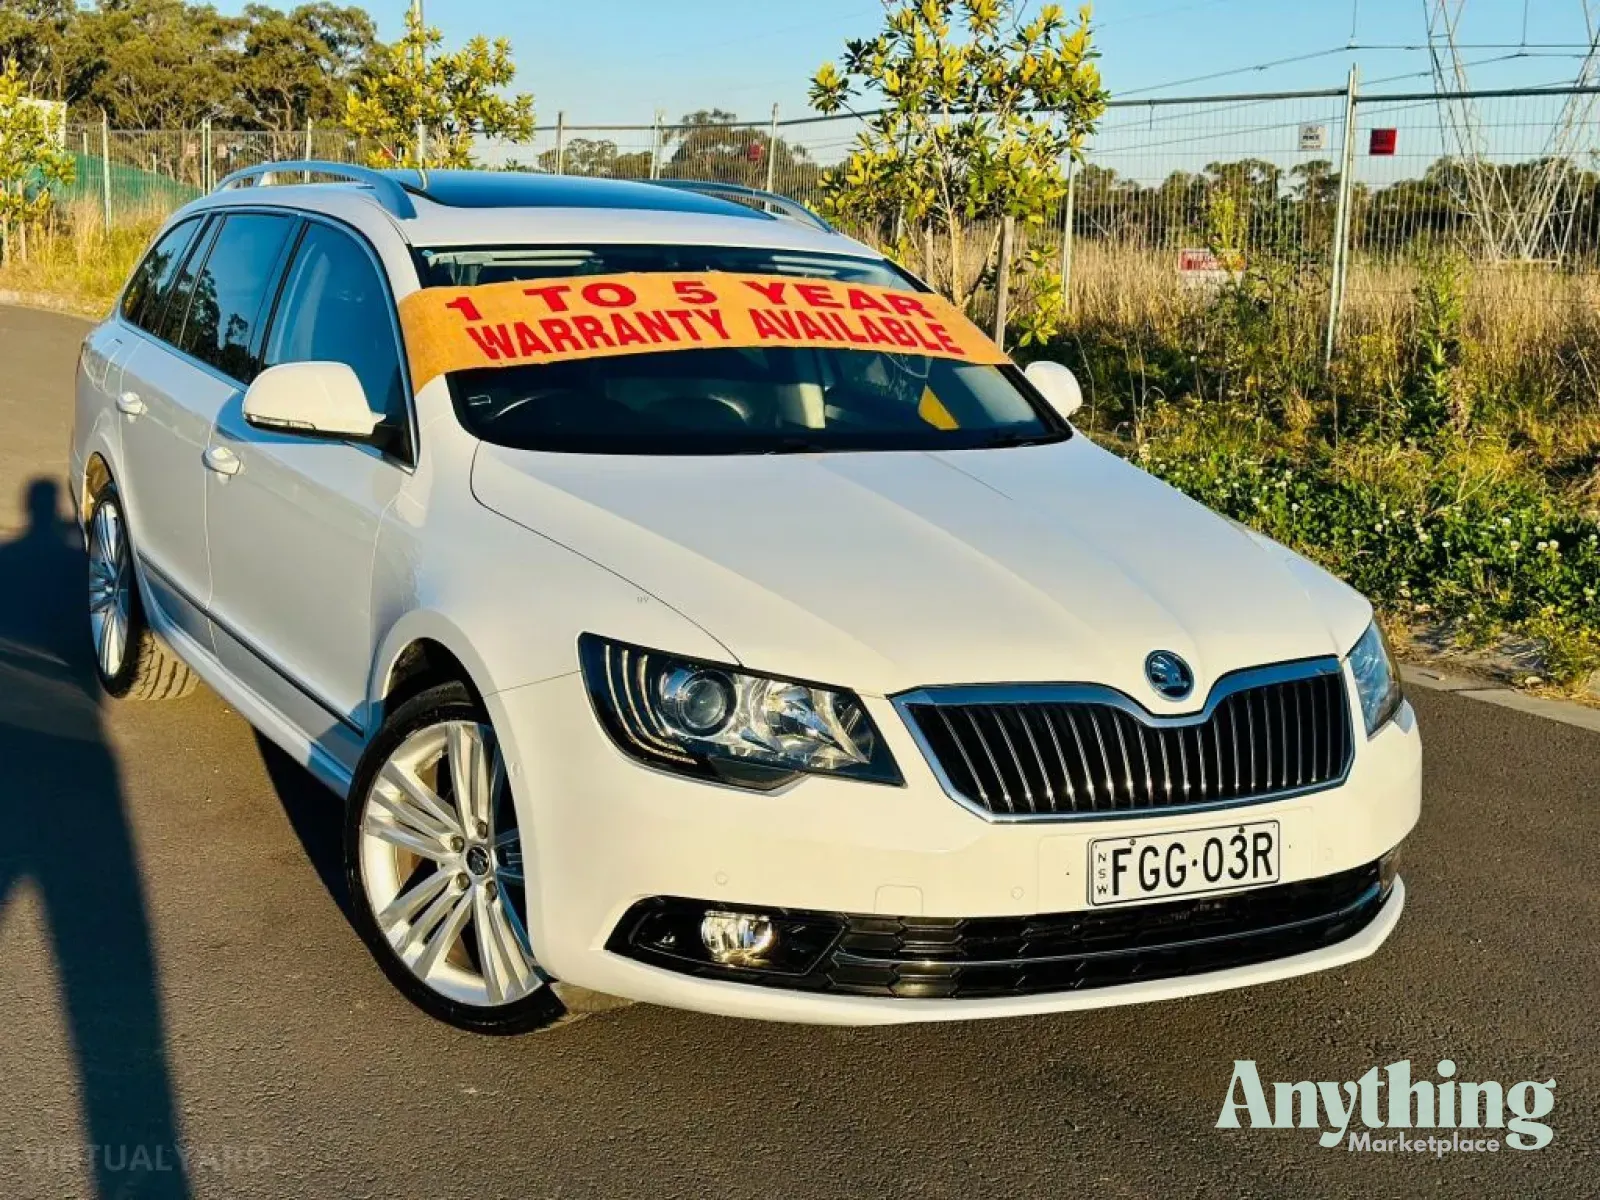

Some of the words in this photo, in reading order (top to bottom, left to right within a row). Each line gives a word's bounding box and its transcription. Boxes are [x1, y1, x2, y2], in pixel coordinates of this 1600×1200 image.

[445, 296, 482, 321] 1
[523, 282, 637, 312] TO
[672, 281, 718, 304] 5
[741, 280, 935, 319] YEAR
[466, 308, 731, 361] WARRANTY
[748, 308, 965, 355] AVAILABLE
